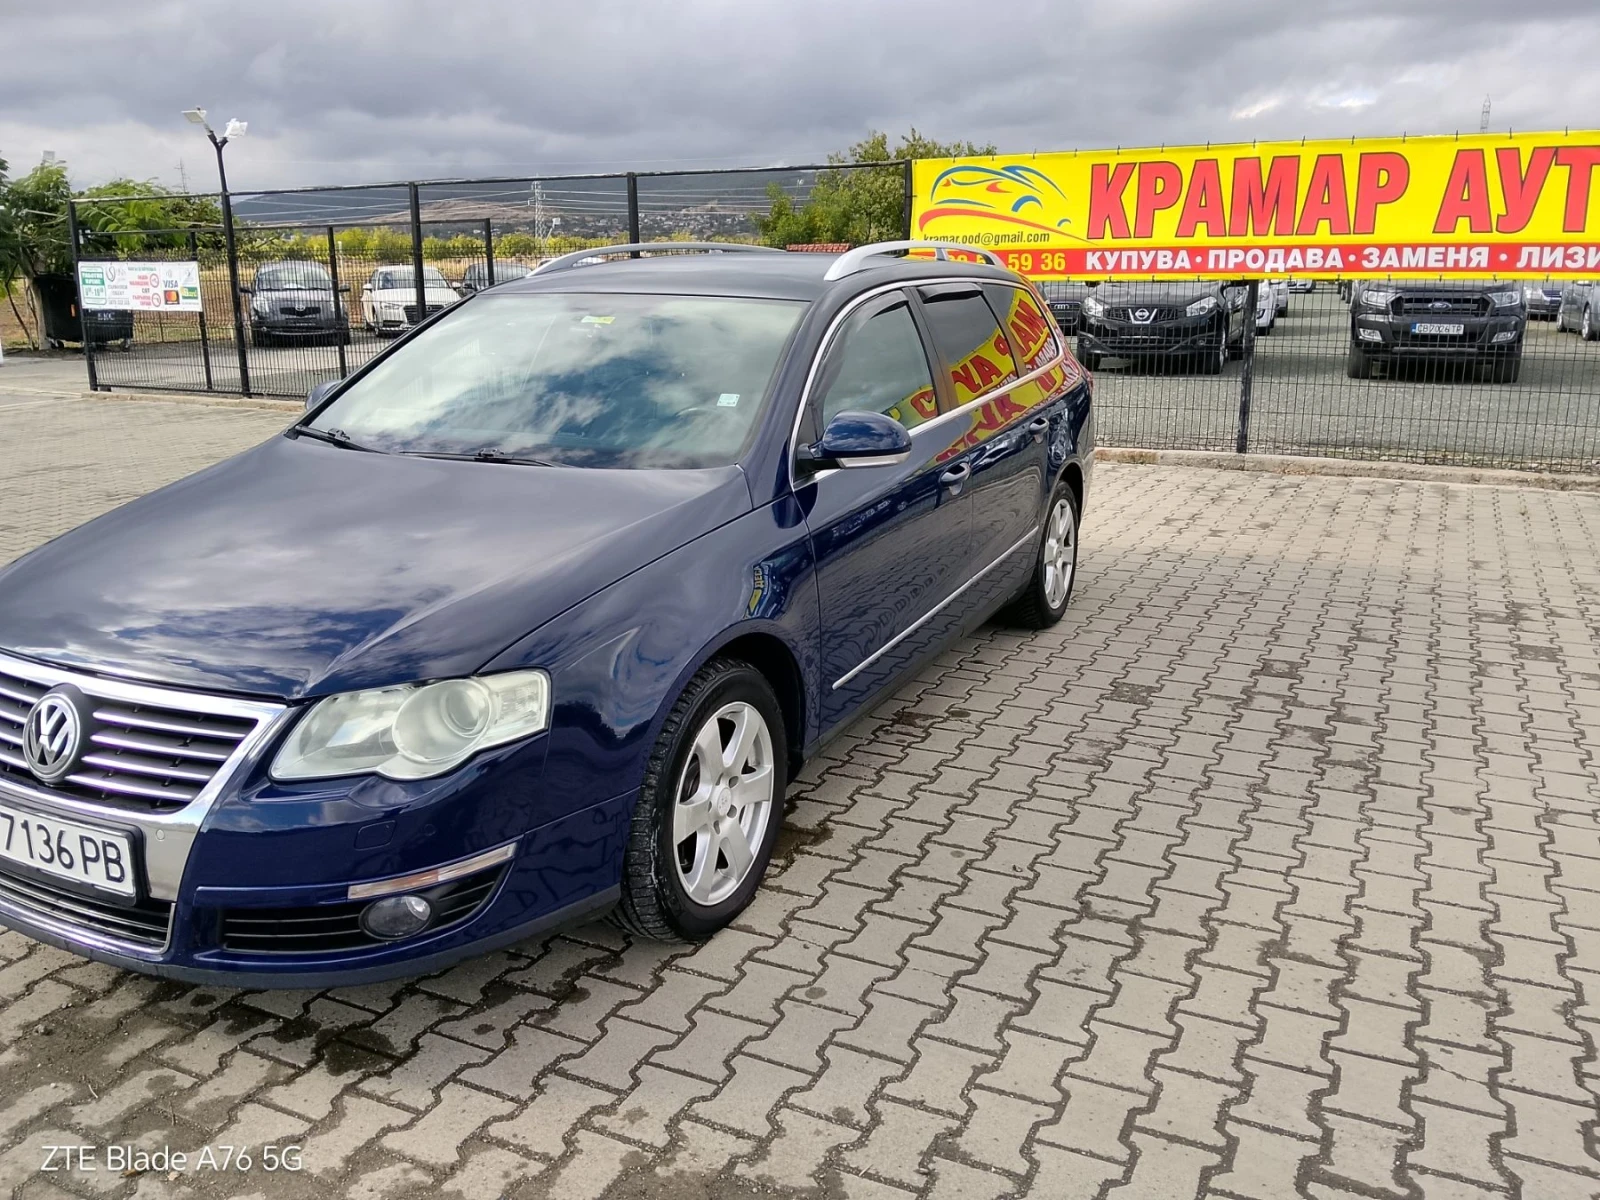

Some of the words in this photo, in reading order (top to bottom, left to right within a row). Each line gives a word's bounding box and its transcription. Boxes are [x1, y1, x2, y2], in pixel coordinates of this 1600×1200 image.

[1087, 151, 1411, 240] КРАМАР
[1432, 145, 1600, 234] АУТ
[924, 231, 1050, 246] kramar.ood@gmail.com
[1041, 253, 1066, 271] 36
[1086, 249, 1190, 271] КУПУВА
[1208, 247, 1343, 272] ПРОДАВА
[1361, 247, 1489, 270] ЗАМЕНЯ
[163, 280, 179, 288] VISA
